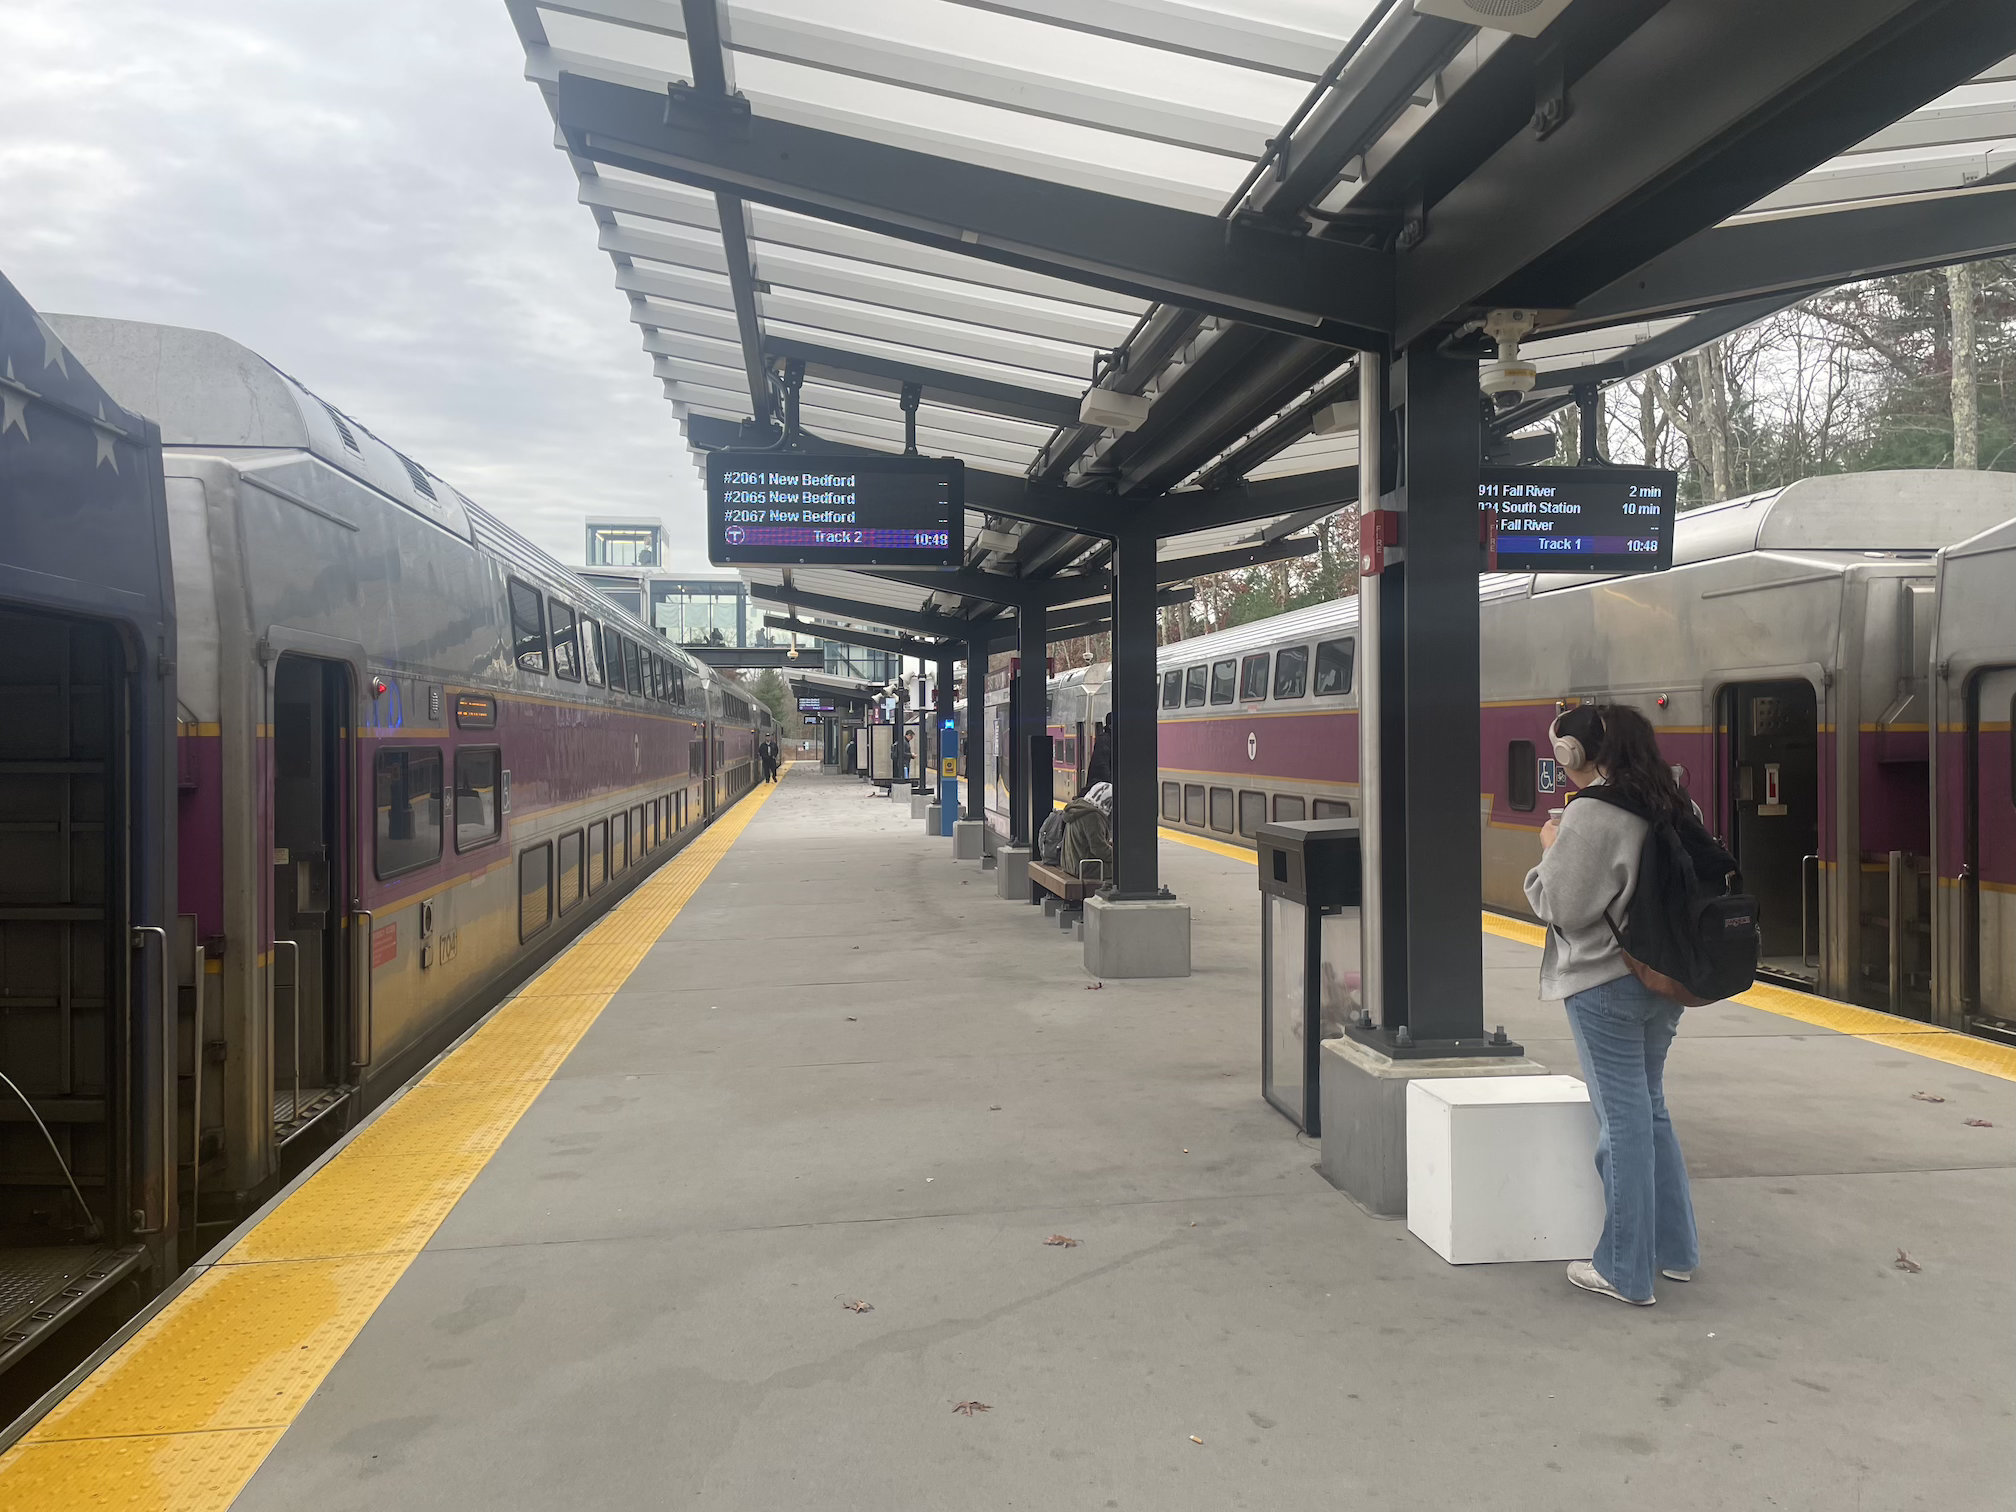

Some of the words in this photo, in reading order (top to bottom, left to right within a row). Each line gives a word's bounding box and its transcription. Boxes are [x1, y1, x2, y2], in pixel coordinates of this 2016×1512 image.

[724, 472, 765, 484] #2061
[769, 473, 799, 485] New
[802, 474, 855, 486] Bedford
[1503, 485, 1523, 496] Fall
[1526, 485, 1556, 496] River
[1629, 486, 1637, 497] 2
[1640, 486, 1661, 497] min
[724, 491, 766, 504] #2065
[769, 491, 799, 503] New
[802, 492, 856, 504] Bedford
[1502, 502, 1537, 513] South
[1539, 502, 1581, 513] Station
[1623, 503, 1636, 514] 10
[1638, 504, 1660, 514] min
[724, 510, 766, 522] #2067
[769, 510, 799, 522] New
[803, 511, 856, 523] Bedford
[1501, 519, 1521, 530] Fall
[1524, 519, 1554, 530] River
[813, 530, 851, 543] Track
[854, 531, 863, 543] 2
[914, 534, 948, 546] 10:48
[1539, 538, 1571, 549] Track
[1575, 538, 1581, 549] 1
[1627, 540, 1658, 551] 10:48
